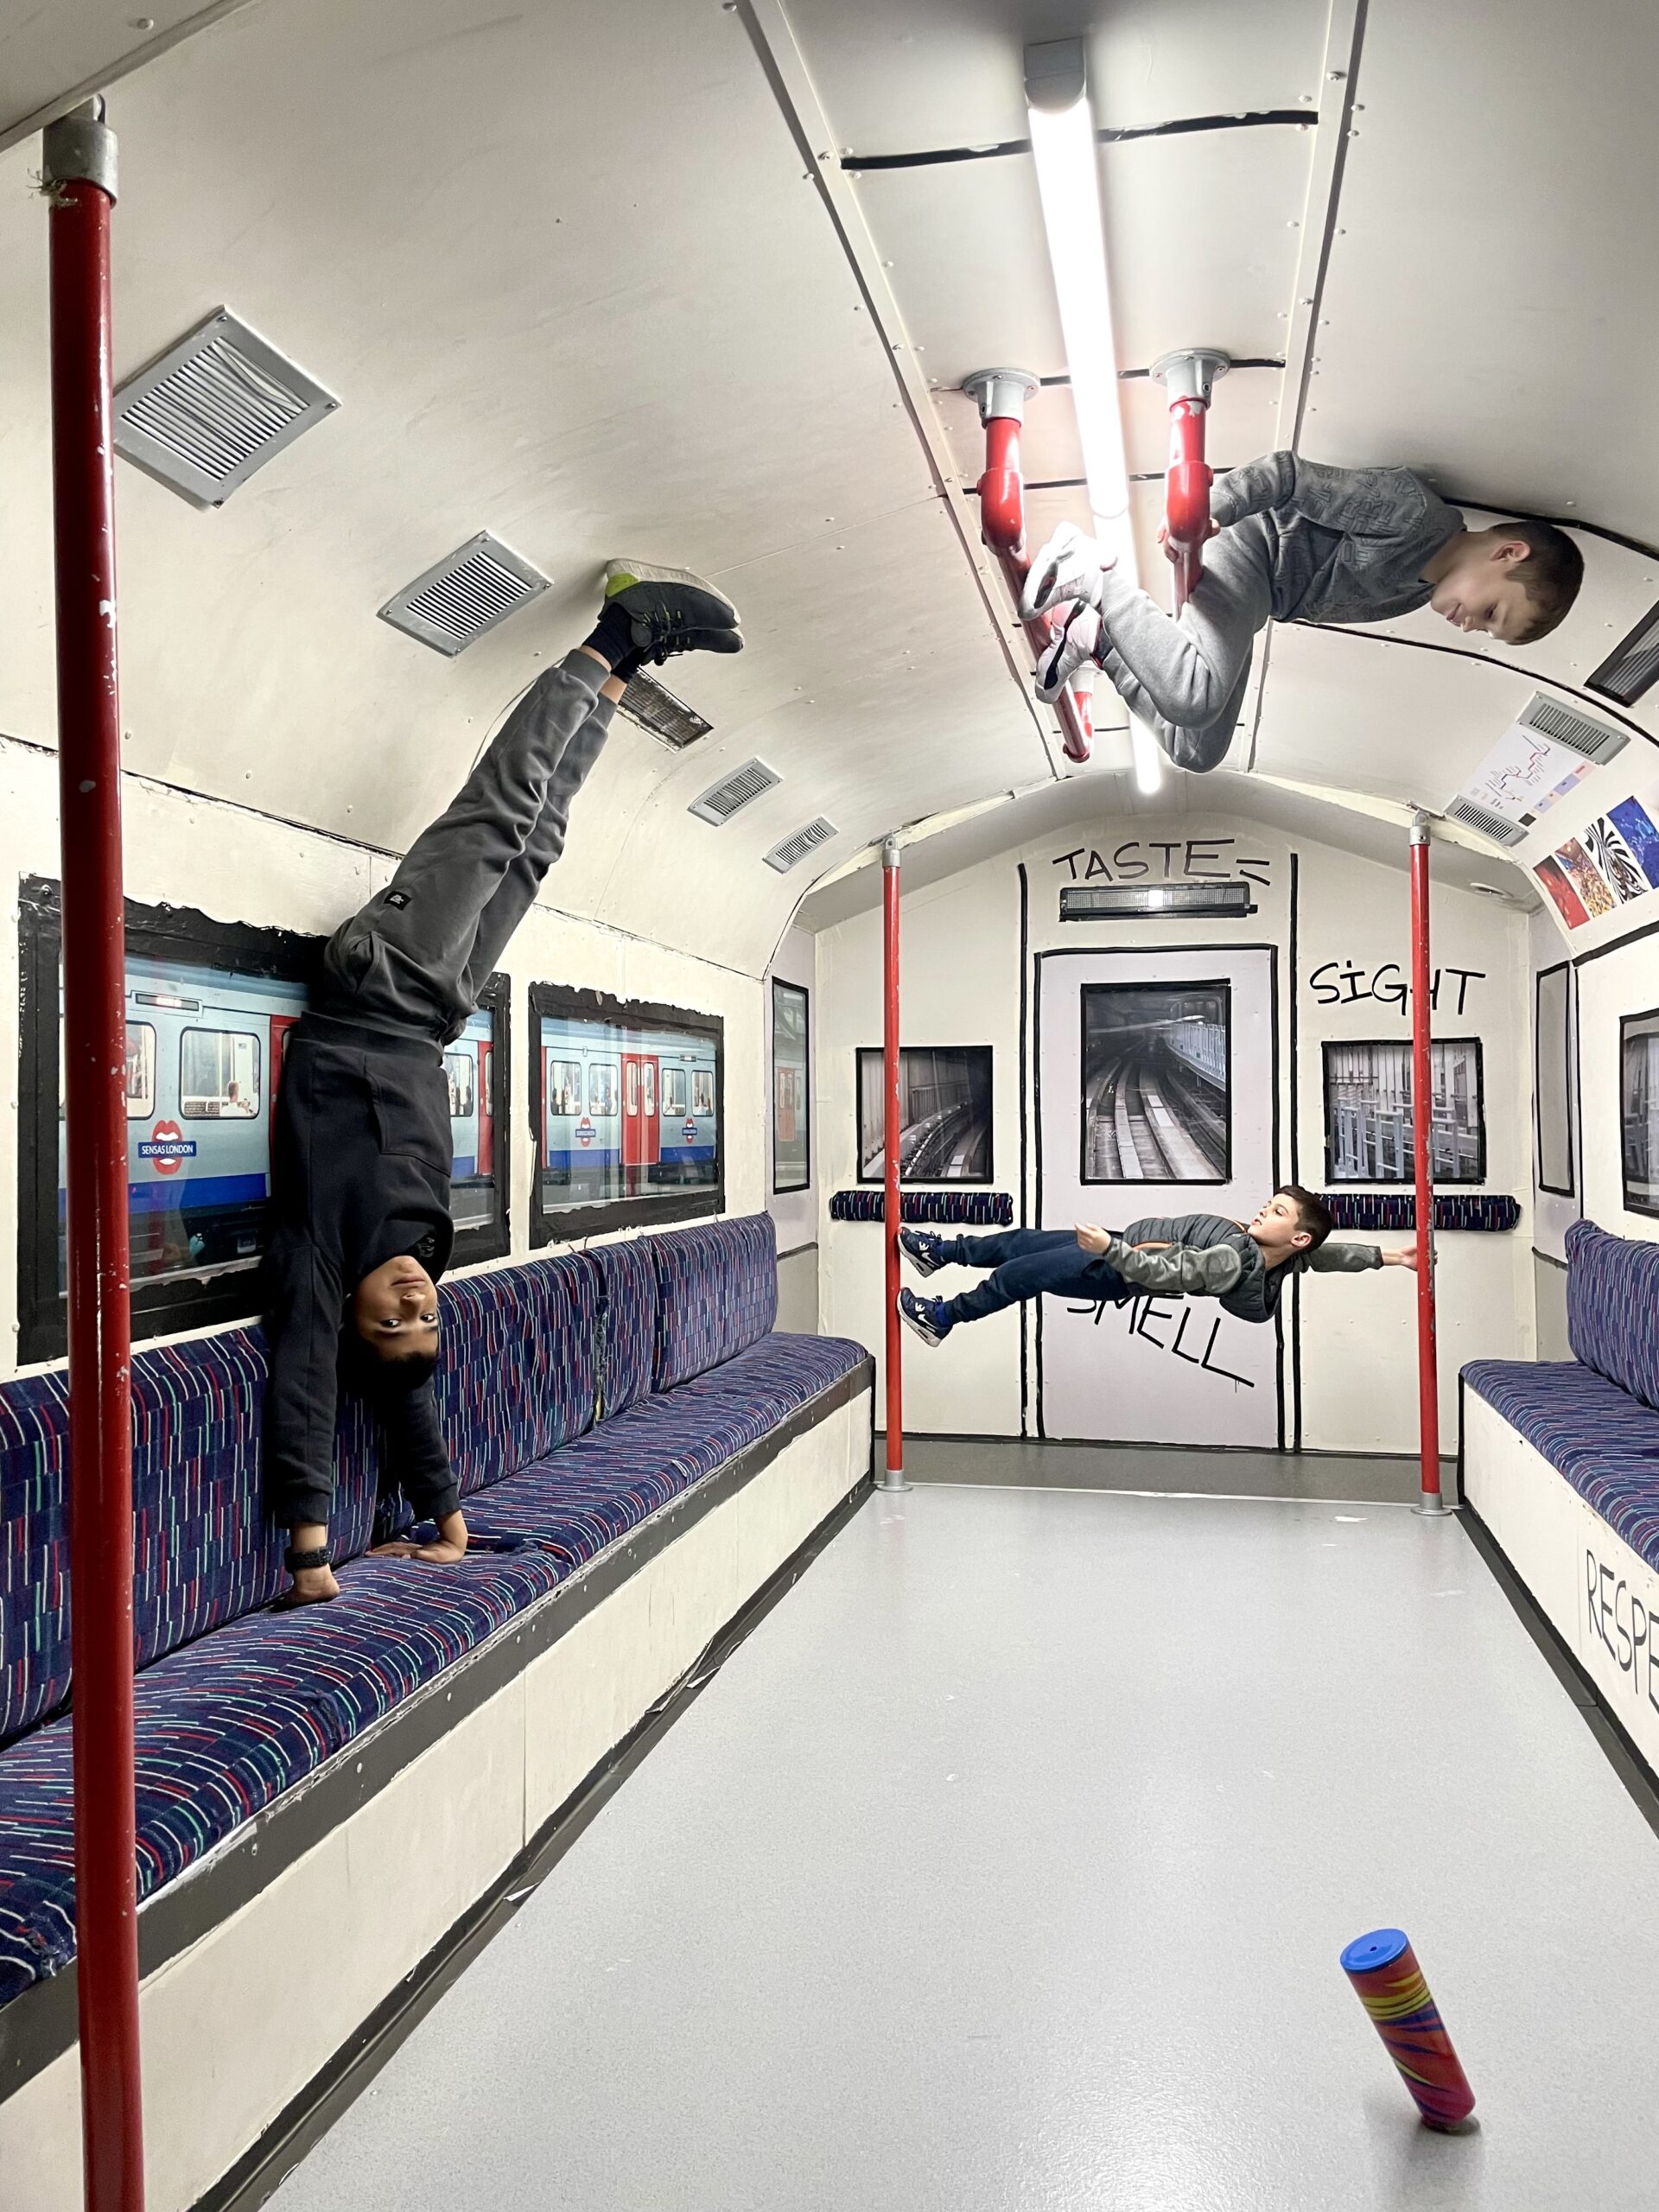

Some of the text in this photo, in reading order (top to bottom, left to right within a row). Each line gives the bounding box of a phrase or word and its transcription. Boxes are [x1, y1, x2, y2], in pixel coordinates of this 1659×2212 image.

[1052, 838, 1235, 882] TASTE
[141, 1144, 194, 1155] SENSAS LONDON
